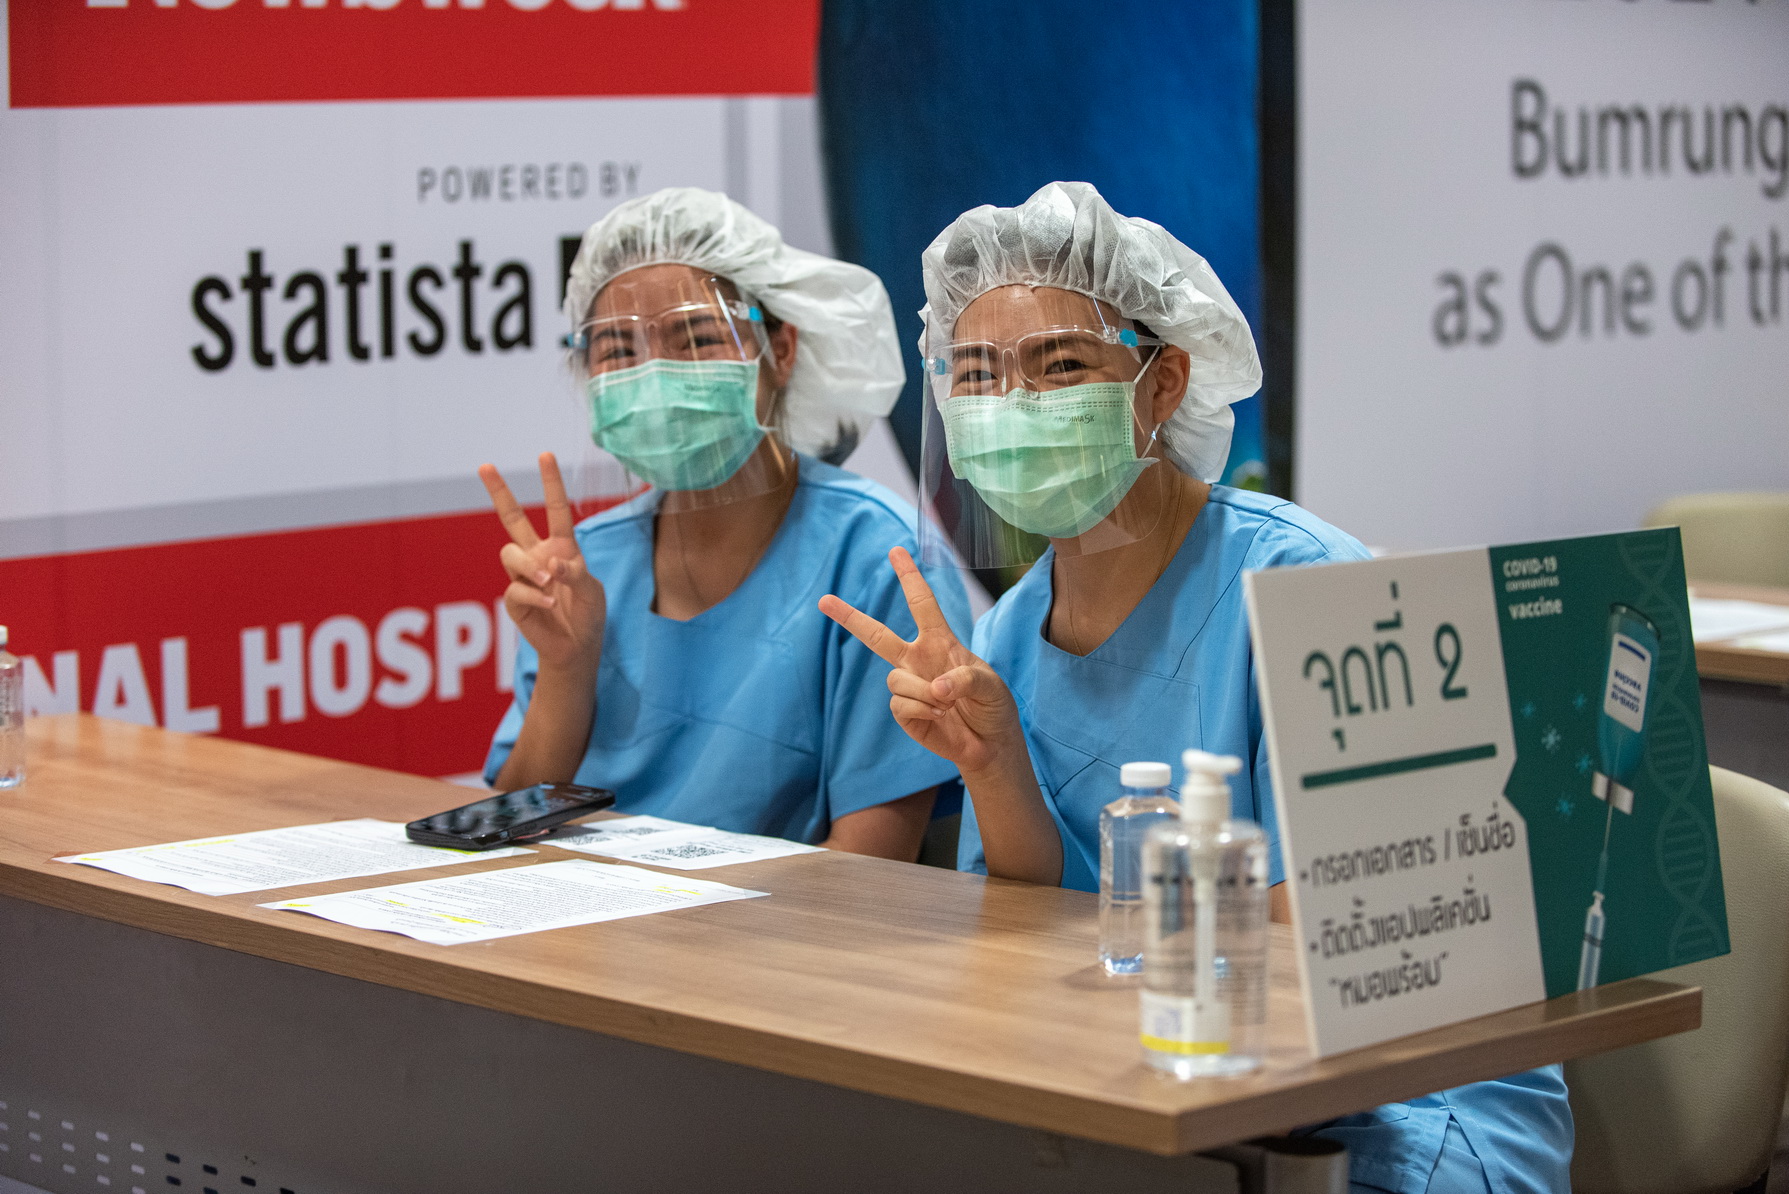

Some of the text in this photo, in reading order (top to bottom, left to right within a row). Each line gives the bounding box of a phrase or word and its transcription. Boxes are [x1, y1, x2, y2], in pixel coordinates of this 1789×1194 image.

[417, 161, 641, 203] POWERED BY
[1509, 77, 1789, 199] Bumrung
[190, 237, 535, 372] statista
[1431, 268, 1503, 347] as
[1521, 241, 1655, 343] One
[1671, 226, 1733, 332] of
[1503, 556, 1558, 578] COVID-19
[1508, 596, 1563, 620] vaccine
[1303, 580, 1413, 752] จุดที่
